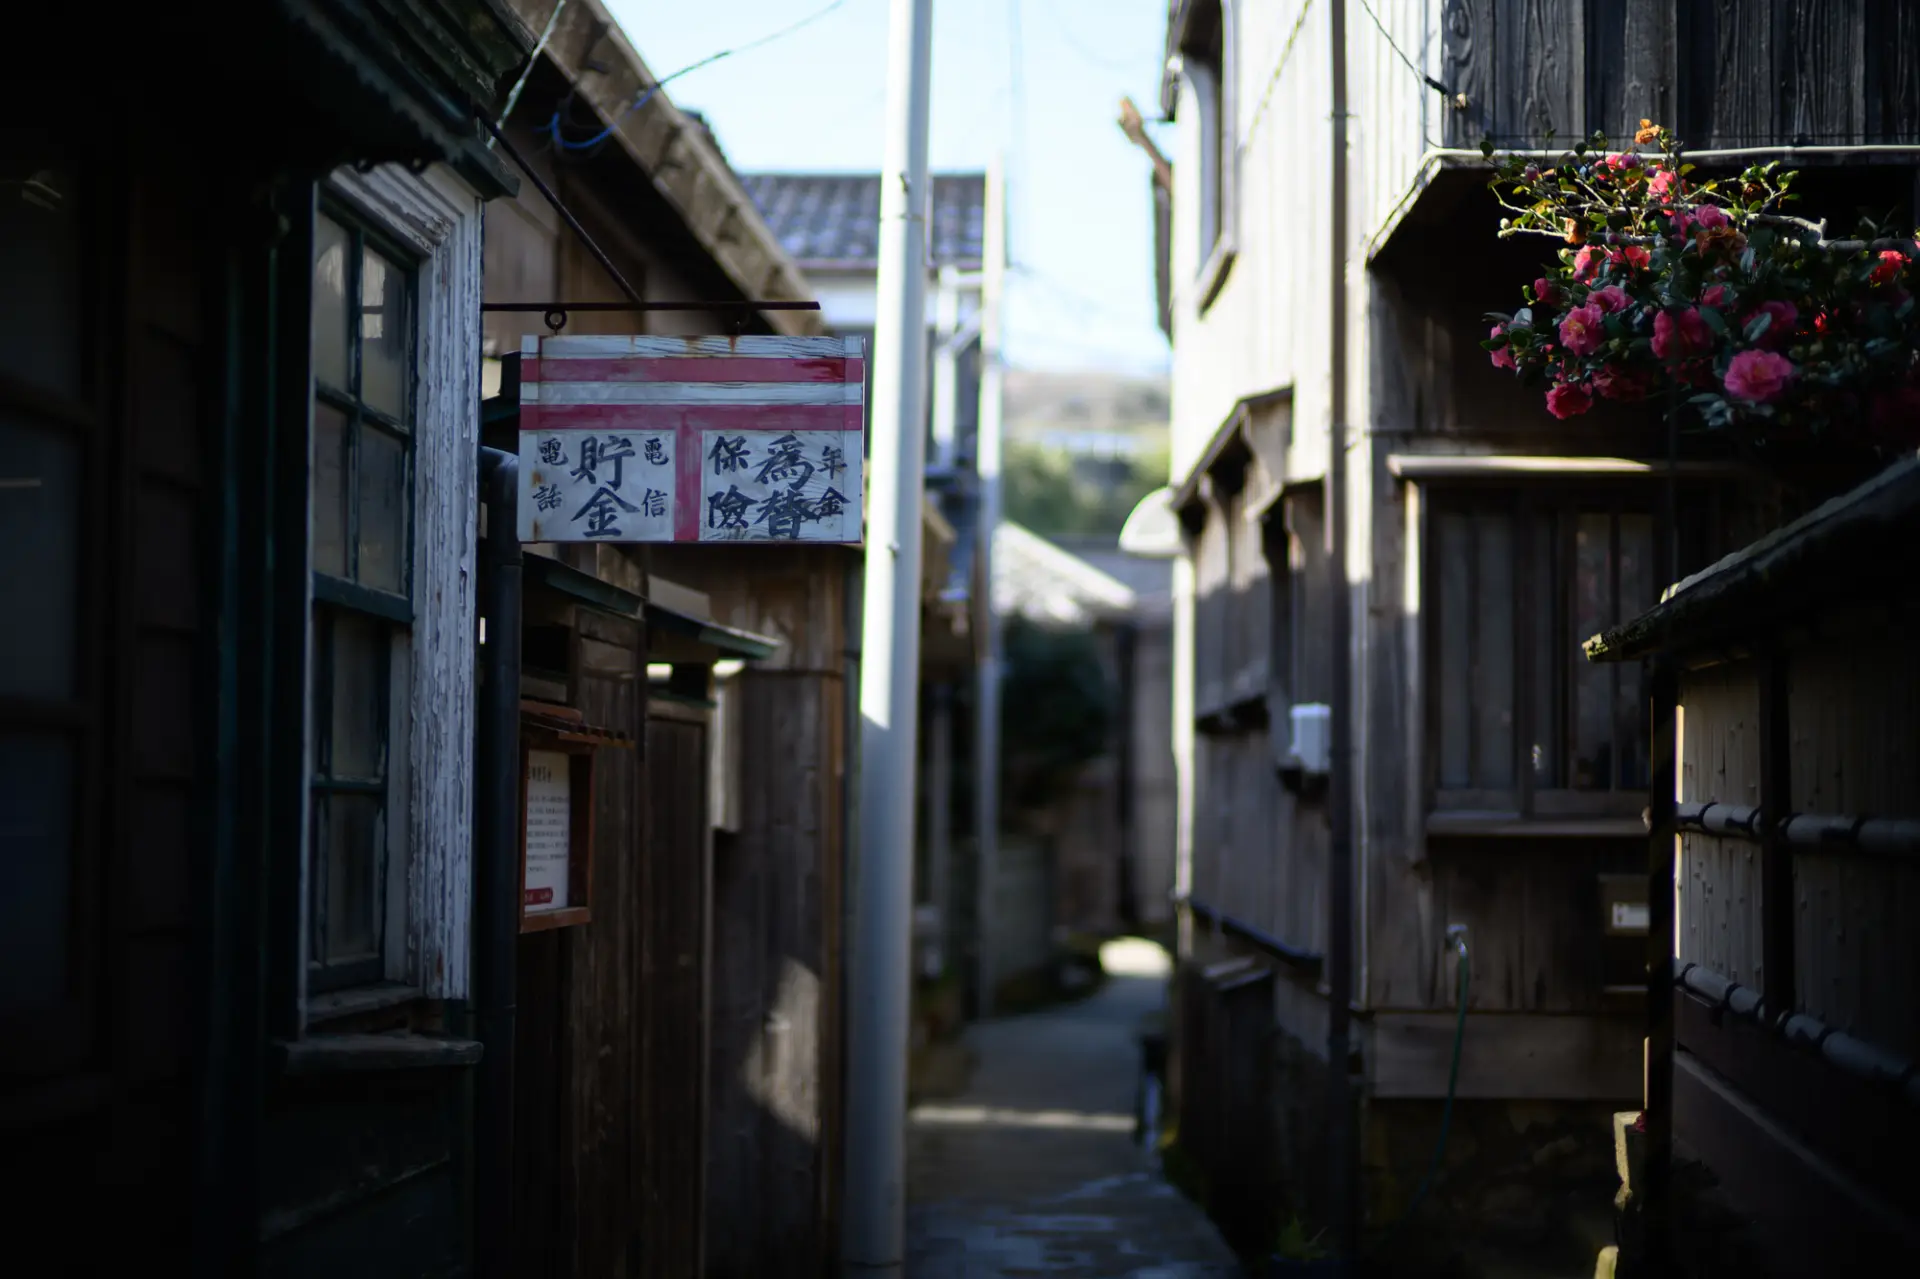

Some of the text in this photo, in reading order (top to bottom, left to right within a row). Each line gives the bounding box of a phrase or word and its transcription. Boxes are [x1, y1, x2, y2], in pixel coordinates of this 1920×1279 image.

[532, 438, 569, 512] 電話
[570, 435, 640, 537] 貯金
[641, 438, 669, 517] 電信
[816, 445, 851, 517] 年金
